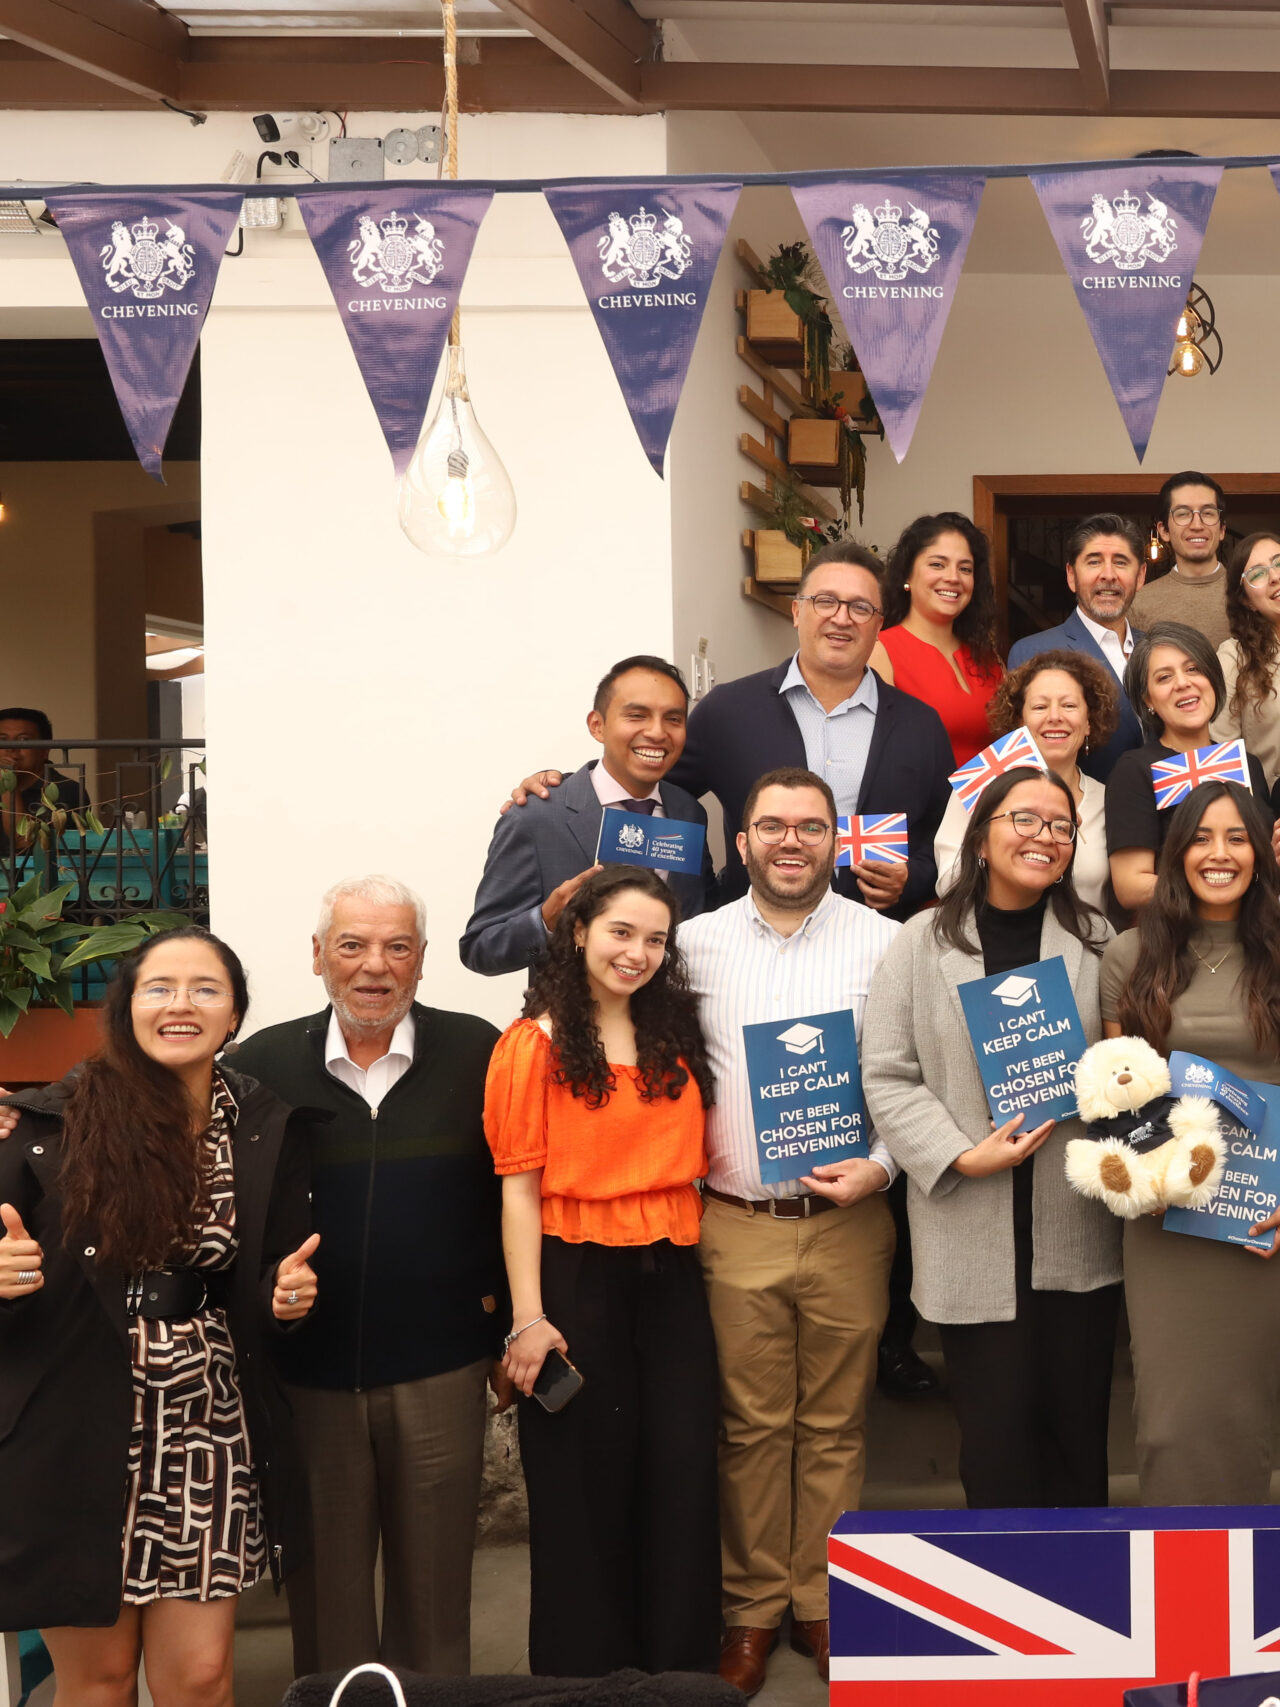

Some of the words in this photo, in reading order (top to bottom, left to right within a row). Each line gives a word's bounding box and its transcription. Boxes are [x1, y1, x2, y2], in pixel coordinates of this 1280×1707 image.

[1082, 275, 1181, 289] CHEVENING
[598, 292, 697, 309] CHEVENING
[843, 286, 944, 299] CHEVENING
[101, 303, 199, 319] CHEVENING
[348, 297, 447, 313] CHEVENING
[615, 846, 643, 855] CHEVENING
[652, 840, 684, 851] Celebrating
[657, 853, 686, 862] excellence
[999, 1021, 1005, 1033] I
[1007, 1009, 1046, 1030] CAN'T
[982, 1033, 1022, 1055] KEEP
[1025, 1018, 1071, 1042] CALM
[779, 1067, 784, 1079] I
[787, 1060, 828, 1077] CAN'T
[1006, 1060, 1031, 1077] I'VE
[1032, 1049, 1066, 1069] BEEN
[759, 1081, 800, 1099] KEEP
[804, 1071, 850, 1091] CALM
[989, 1068, 1056, 1098] CHOSEN
[1058, 1061, 1079, 1079] FO
[998, 1080, 1077, 1114] CHEVENIN
[779, 1108, 804, 1123] I'VE
[807, 1102, 840, 1118] BEEN
[759, 1119, 827, 1144] CHOSEN
[830, 1113, 862, 1131] FOR
[1219, 1123, 1257, 1140] CAN'
[765, 1129, 861, 1160] CHEVENING!
[1230, 1142, 1278, 1162] CALM
[1224, 1170, 1259, 1187] BEEN
[1244, 1189, 1277, 1207] FOR
